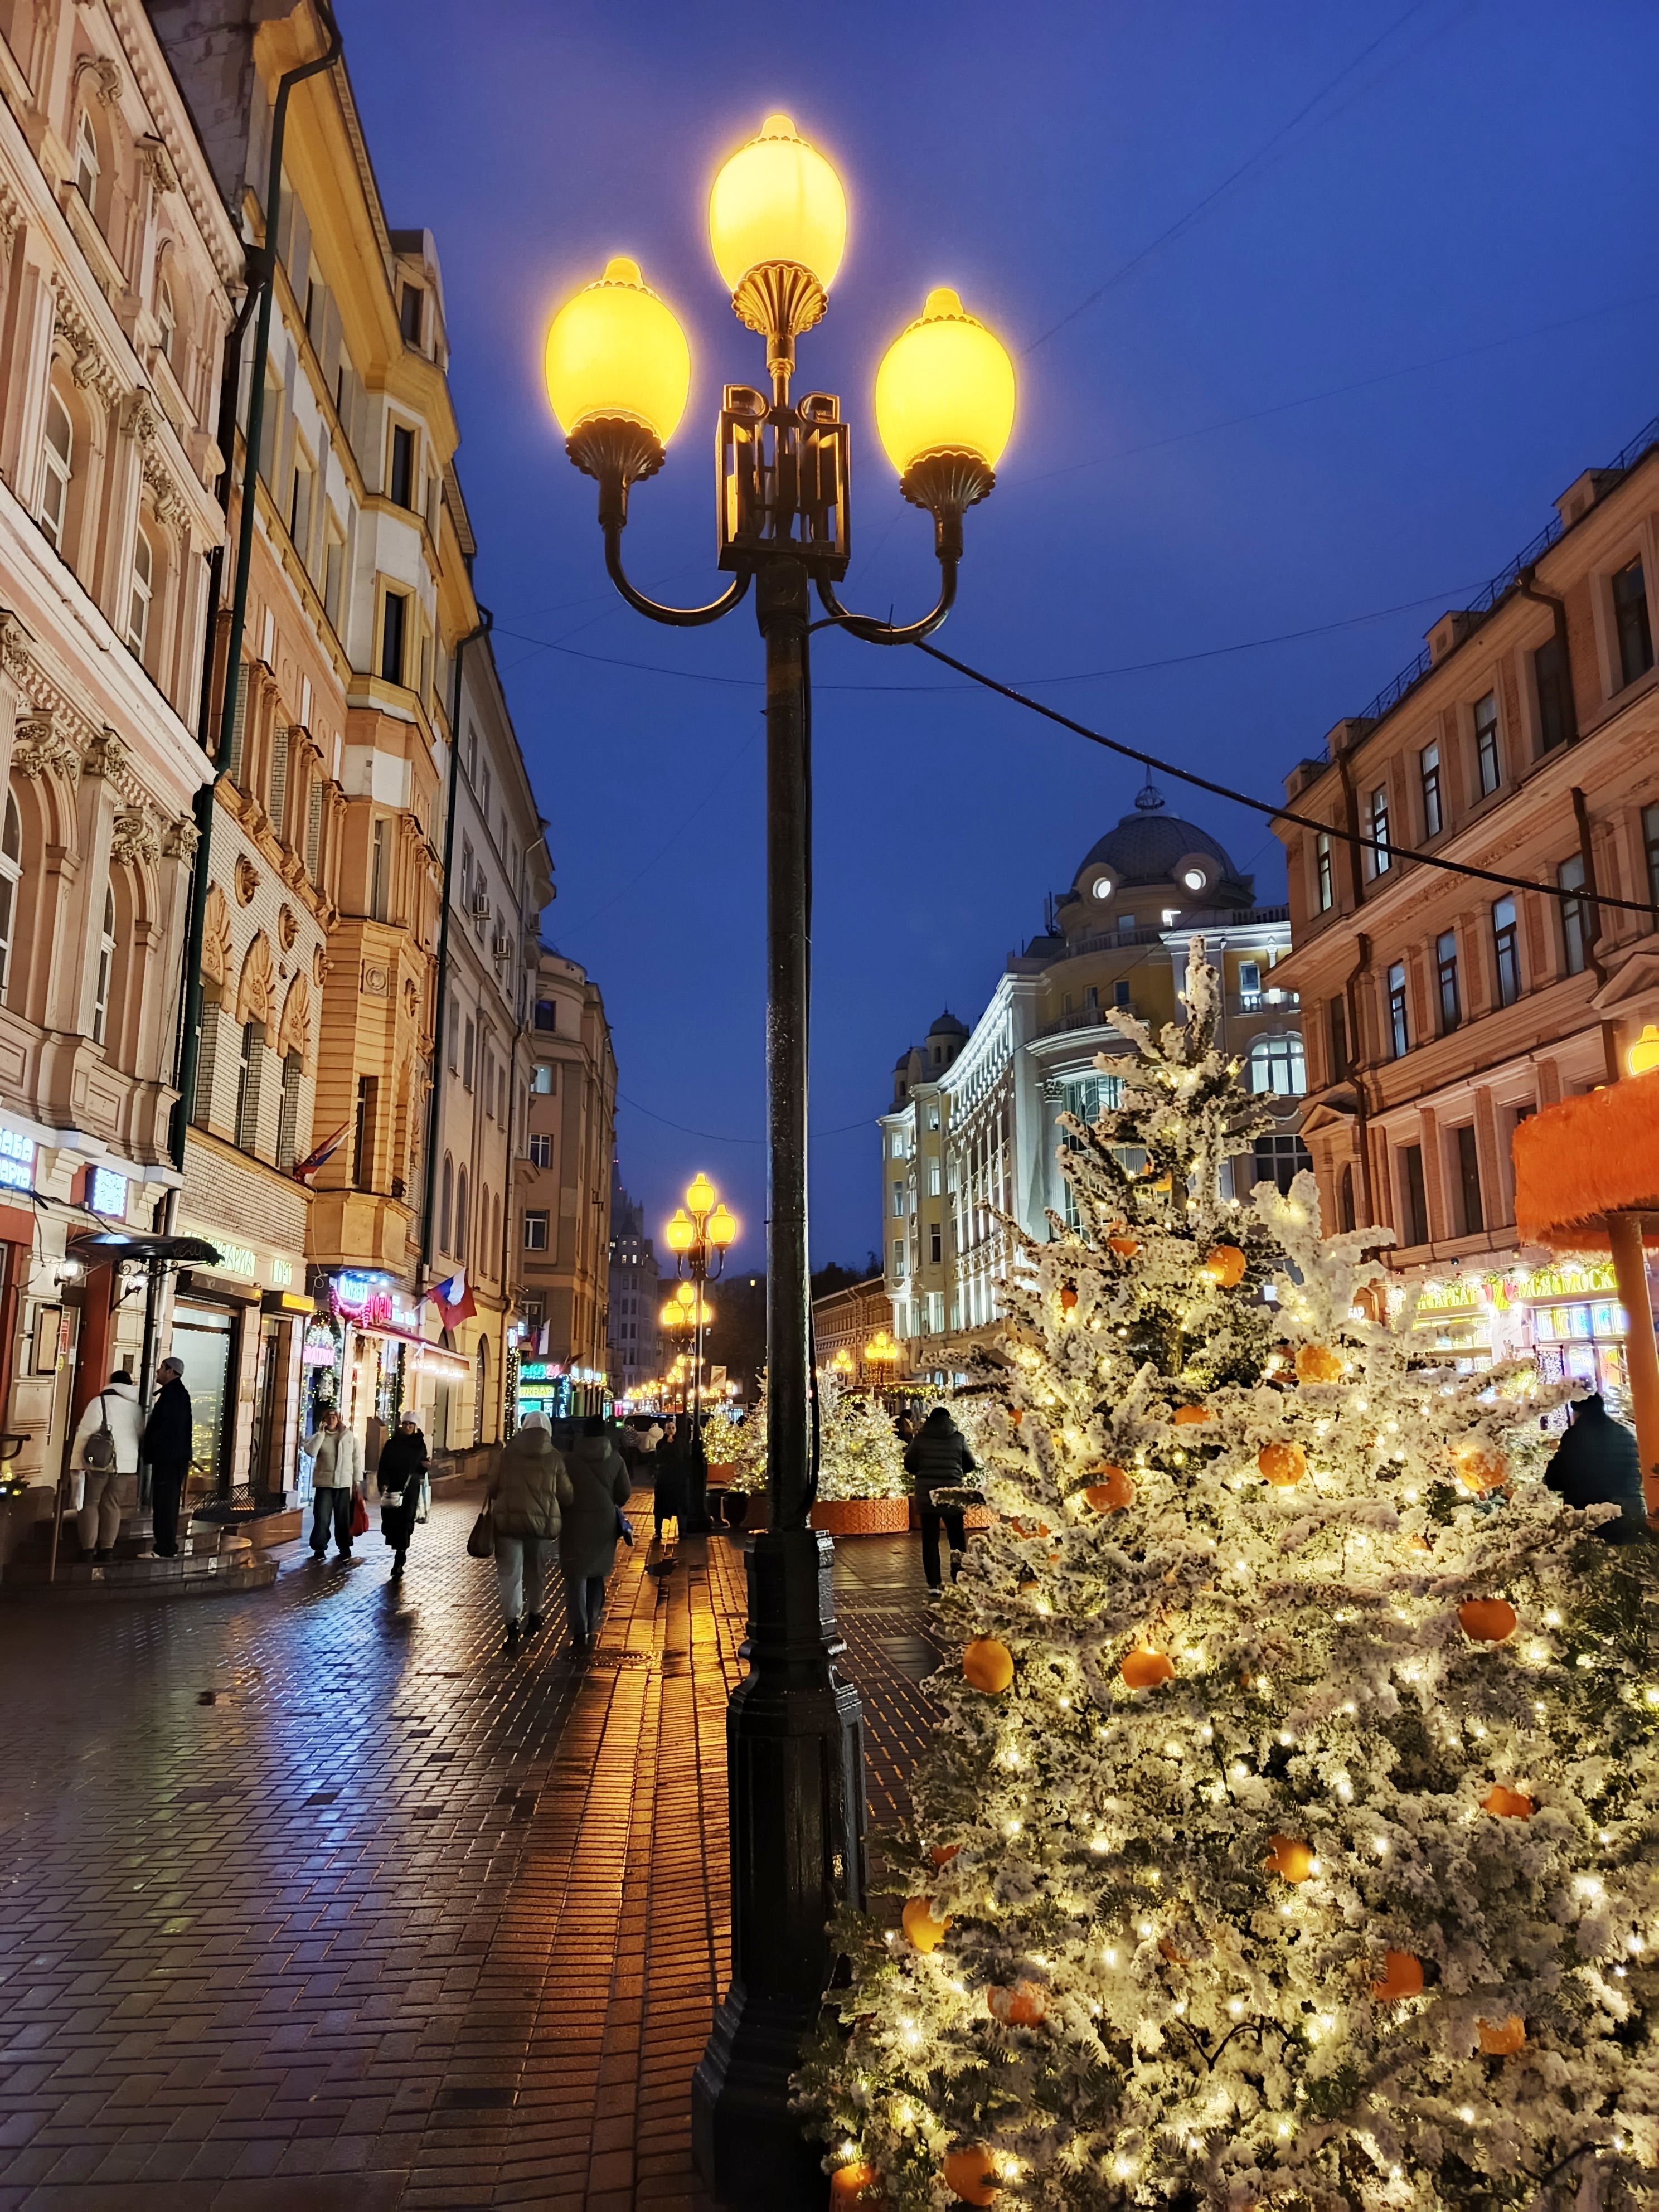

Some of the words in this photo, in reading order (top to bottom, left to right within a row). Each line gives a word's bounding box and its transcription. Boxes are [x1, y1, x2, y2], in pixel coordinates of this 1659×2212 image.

[0, 1127, 33, 1162] АБА
[0, 1159, 31, 1189] АРТА
[1561, 1267, 1617, 1294] МОСК
[519, 1386, 553, 1398] ИКВАР
